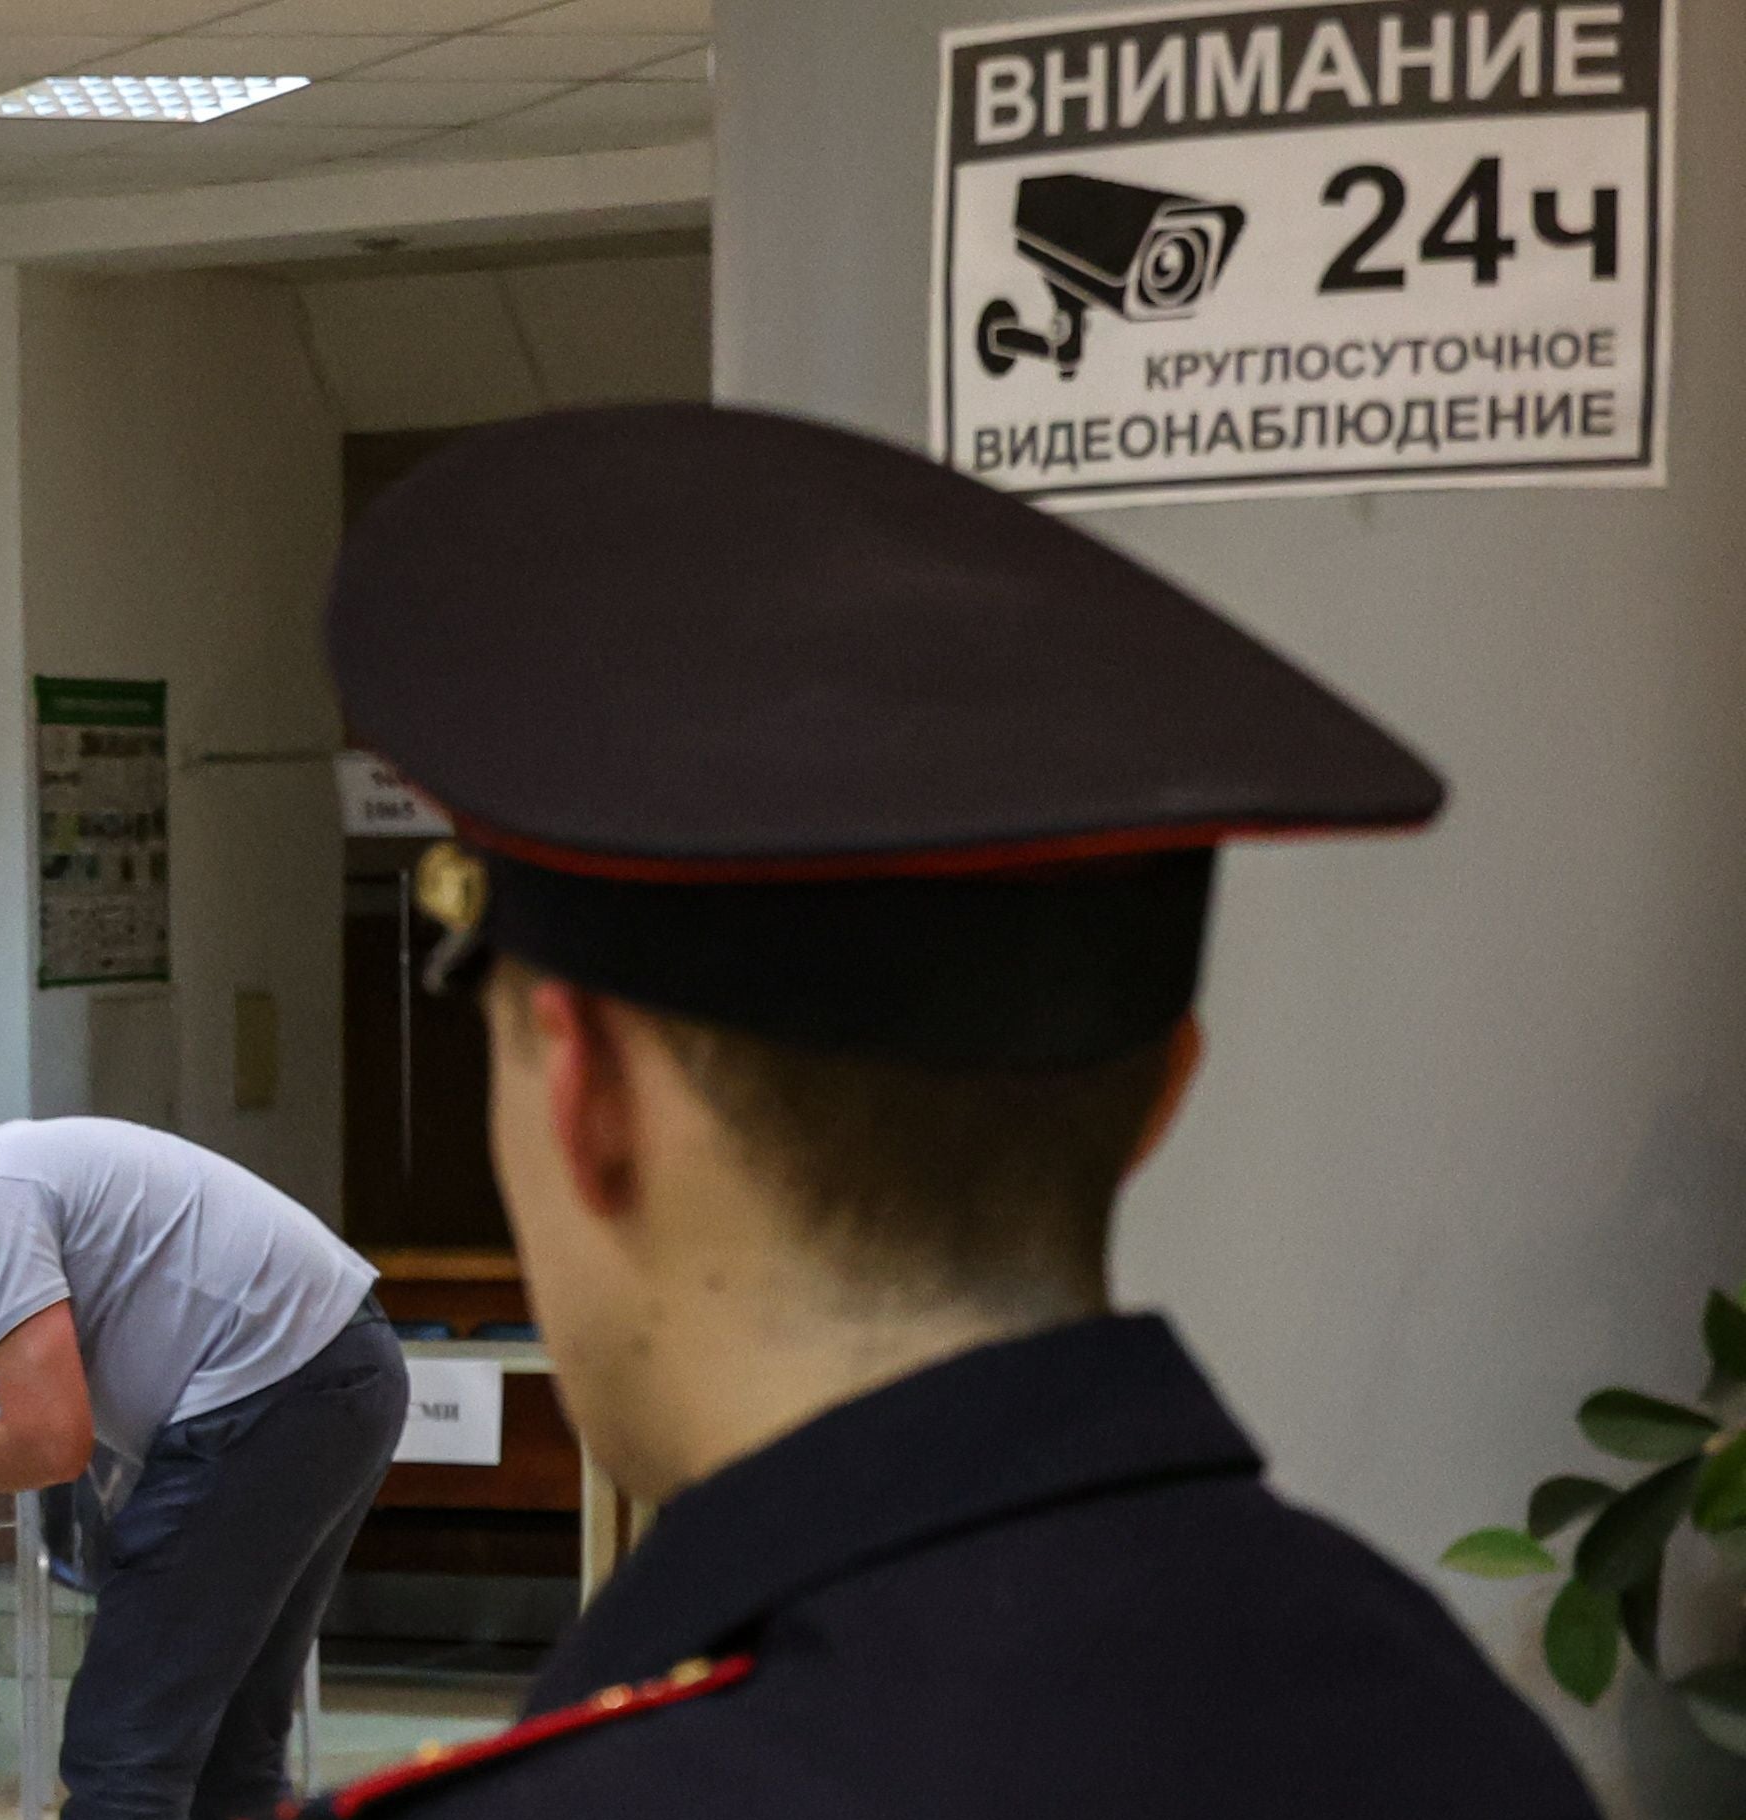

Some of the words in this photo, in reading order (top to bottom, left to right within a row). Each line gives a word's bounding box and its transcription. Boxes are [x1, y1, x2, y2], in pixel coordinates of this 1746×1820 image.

[973, 5, 1625, 146] ВНИМАНИЕ
[1317, 155, 1621, 297] 24ч
[1143, 327, 1616, 391] КРУГЛОСУТОЧНОЕ
[973, 391, 1616, 474] ВИДЕОНАБЛЮДЕНИЕ
